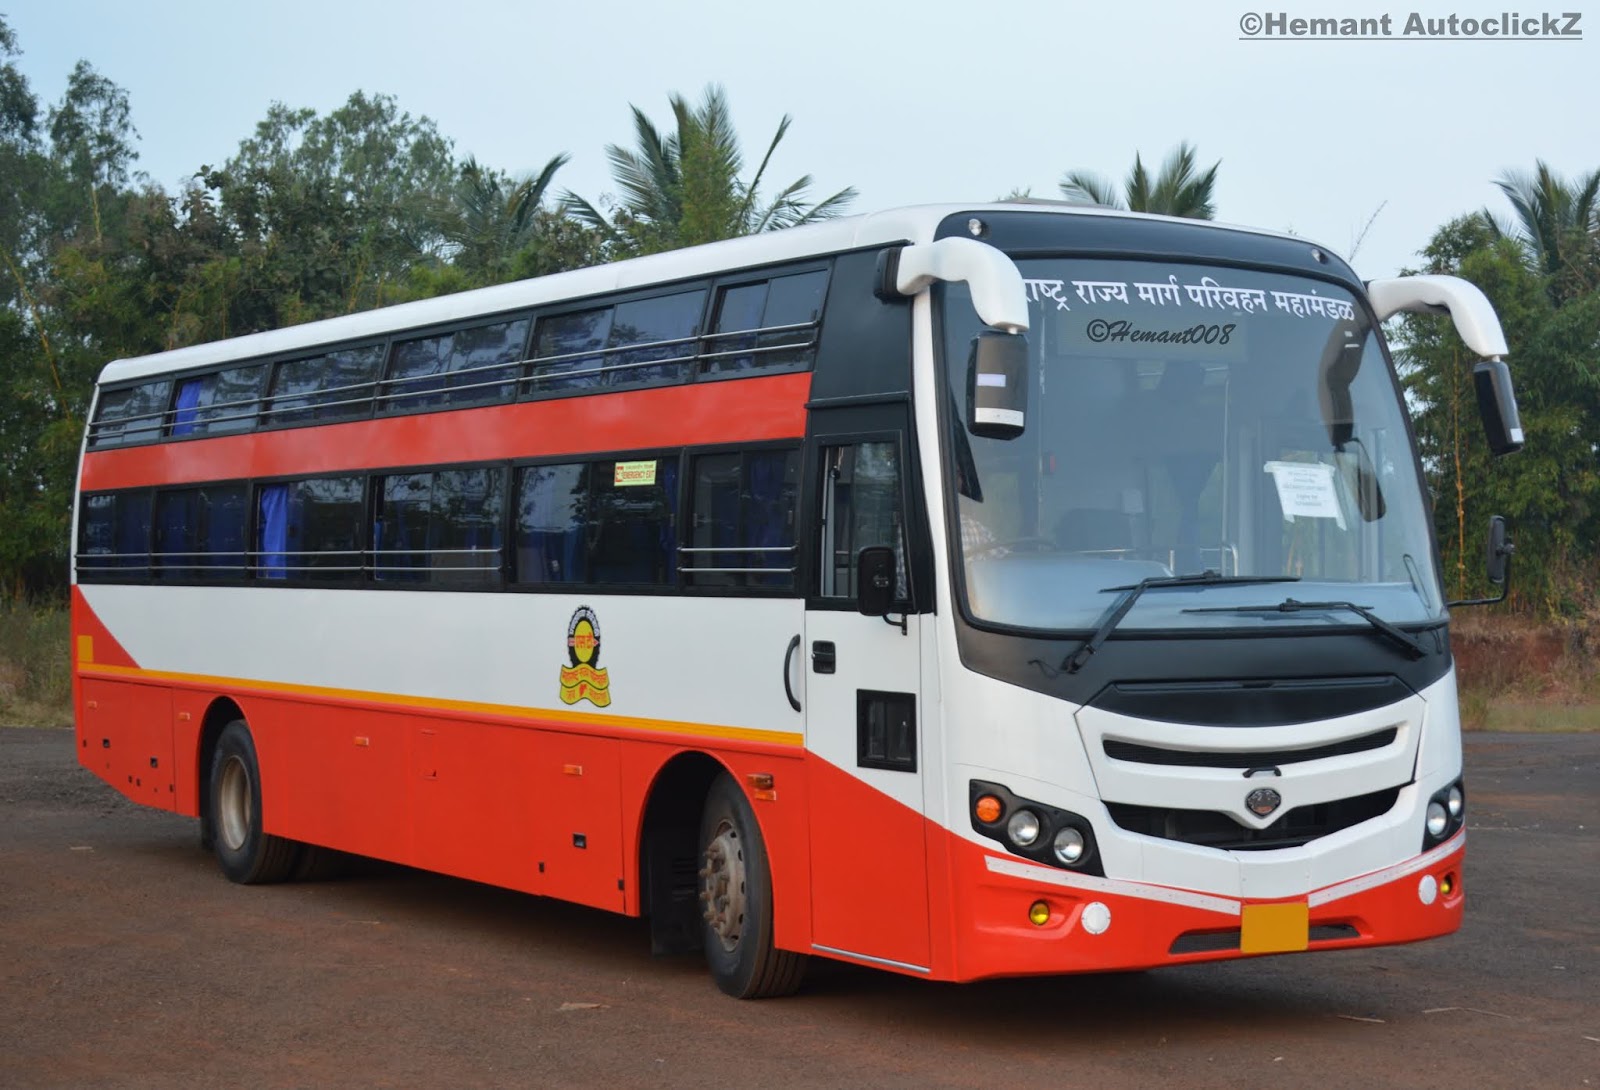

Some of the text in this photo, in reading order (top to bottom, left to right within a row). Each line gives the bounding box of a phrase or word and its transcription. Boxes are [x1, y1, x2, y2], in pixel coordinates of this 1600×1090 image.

[1071, 280, 1130, 304] राज्य
[1133, 274, 1181, 306] मार्ग
[1183, 276, 1268, 314] परिवहन
[1270, 288, 1355, 321] महामंडळ
